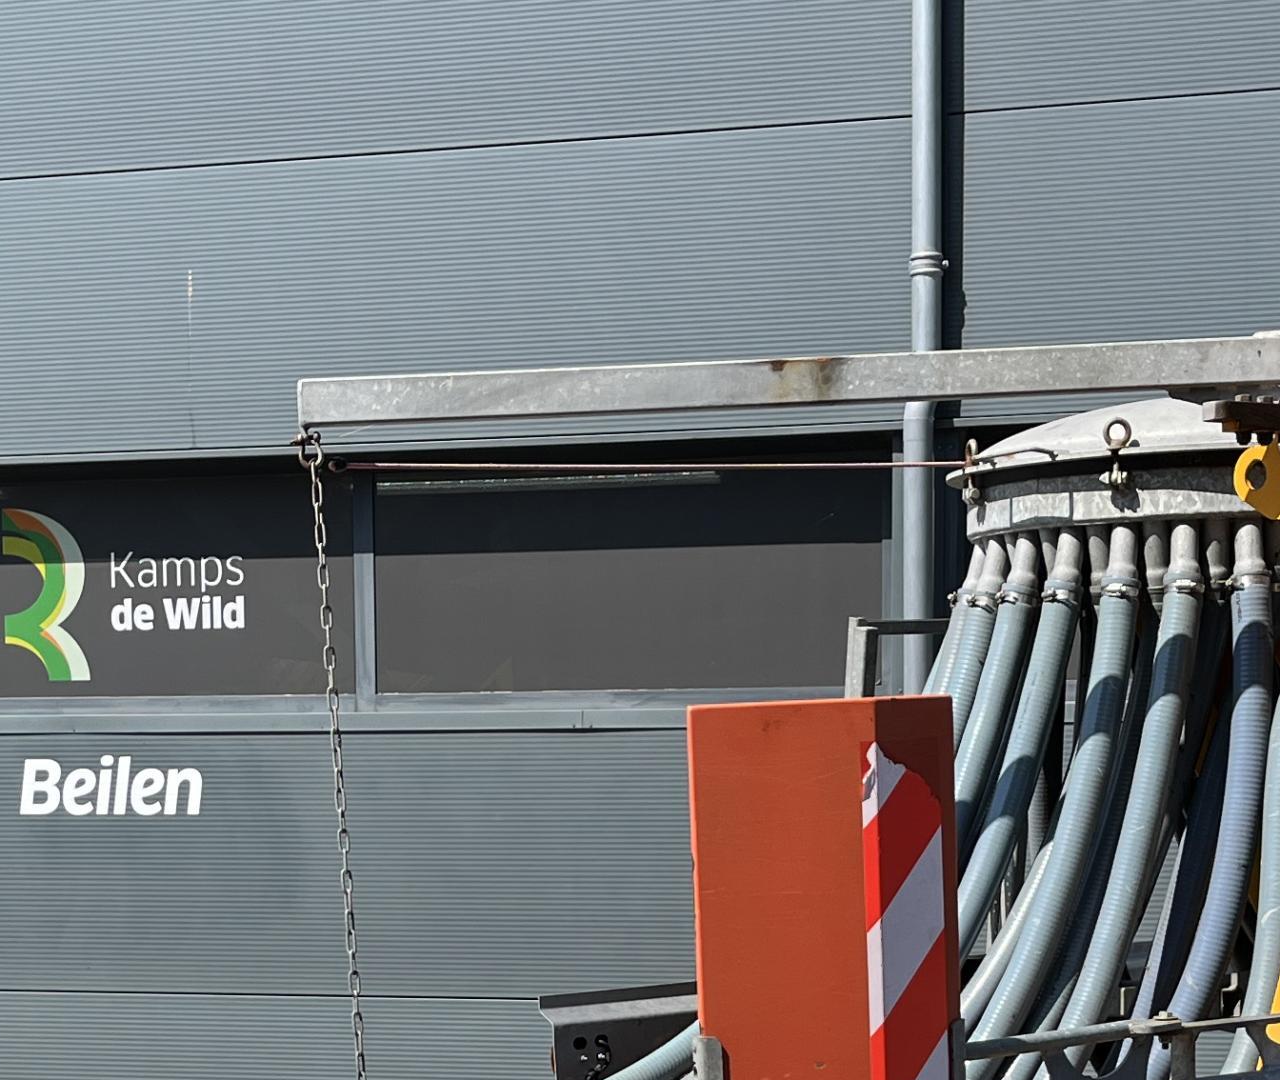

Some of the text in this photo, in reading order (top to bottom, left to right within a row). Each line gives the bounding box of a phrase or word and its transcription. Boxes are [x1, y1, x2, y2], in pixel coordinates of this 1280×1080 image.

[110, 551, 245, 592] Kamps
[110, 595, 246, 632] de Wild
[19, 754, 203, 816] Beilen
